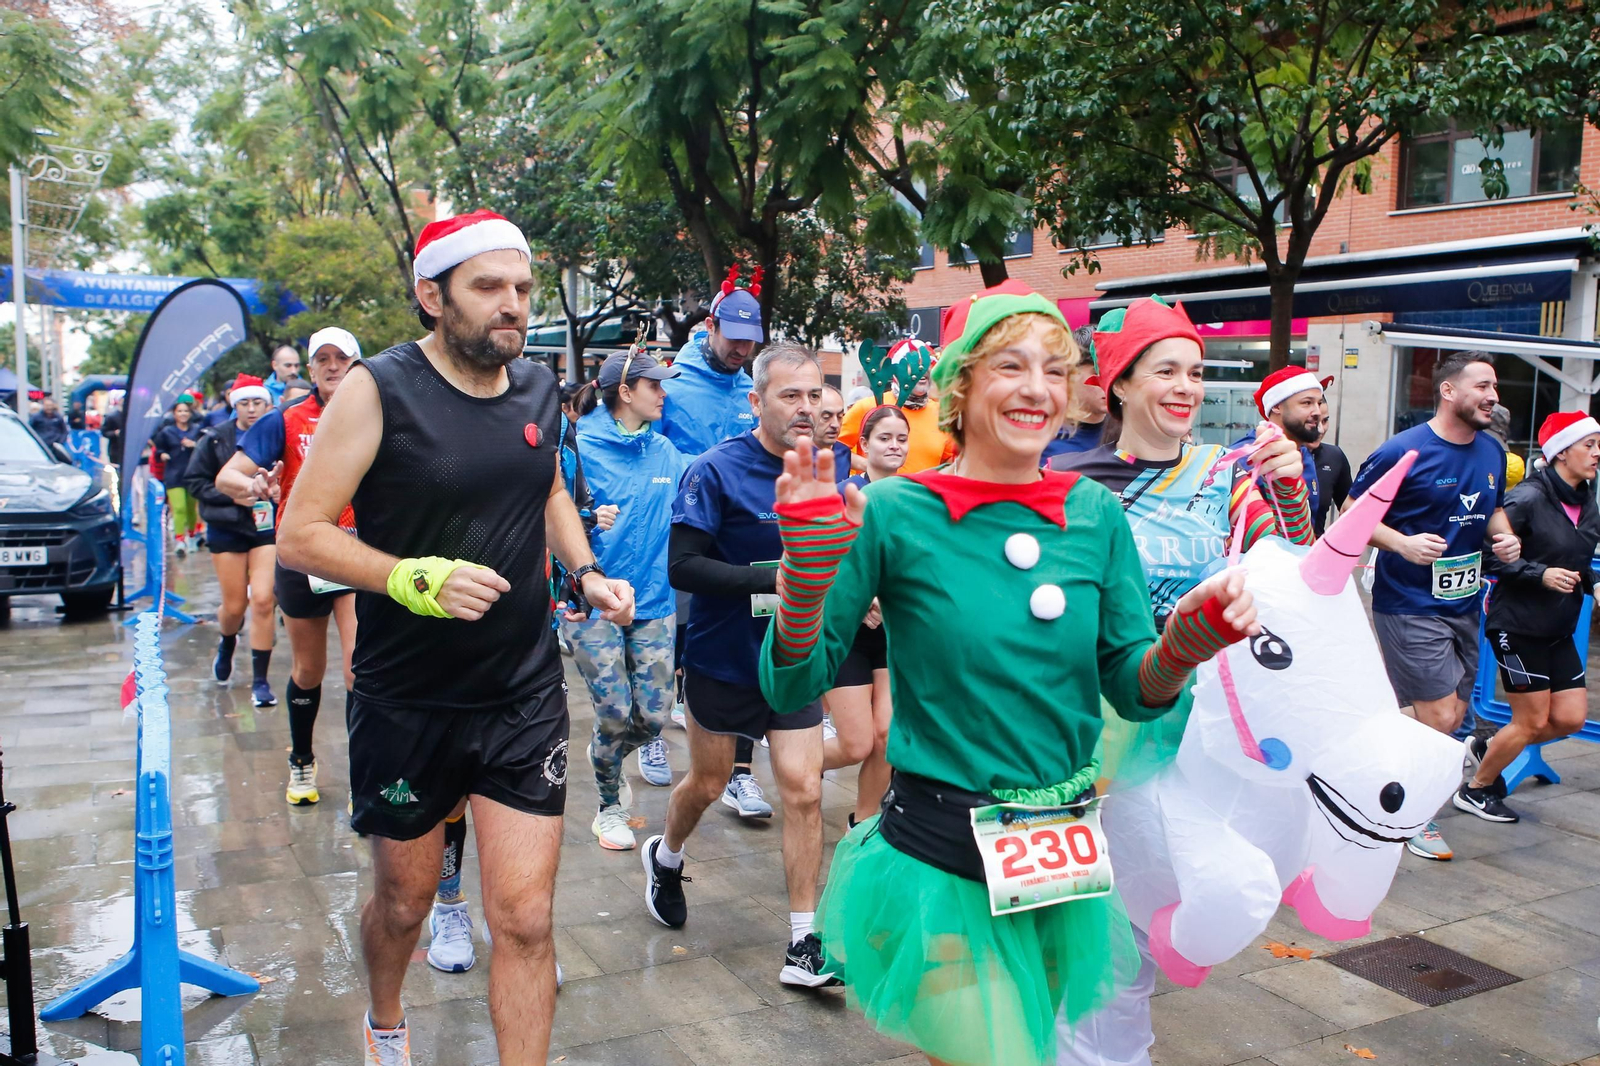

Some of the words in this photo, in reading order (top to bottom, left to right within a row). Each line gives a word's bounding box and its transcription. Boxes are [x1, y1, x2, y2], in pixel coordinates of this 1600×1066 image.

[84, 293, 105, 304] DE
[162, 322, 233, 391] CUPRA
[1147, 568, 1191, 578] TEAM
[1438, 567, 1477, 590] 673
[995, 824, 1098, 879] 230
